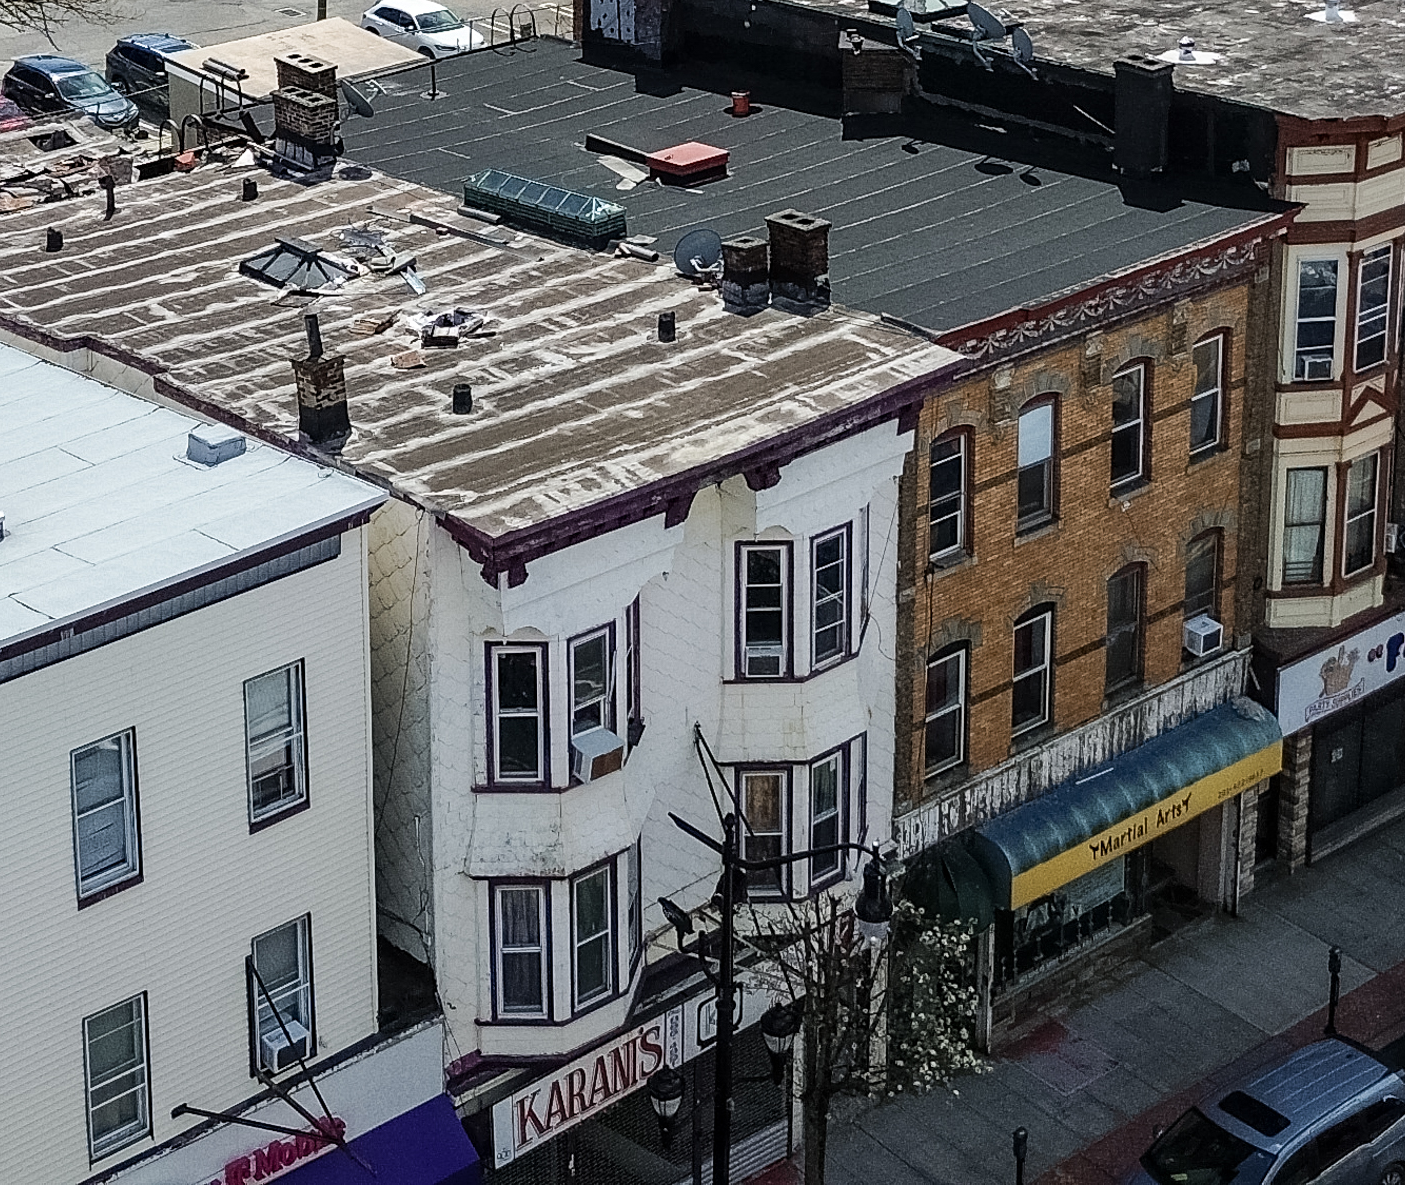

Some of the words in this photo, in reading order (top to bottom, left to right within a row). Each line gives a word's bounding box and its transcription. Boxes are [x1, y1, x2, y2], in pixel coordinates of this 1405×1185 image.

[1100, 816, 1148, 857] Martial
[1156, 802, 1182, 828] Arts
[515, 1025, 663, 1149] KARANI'S
